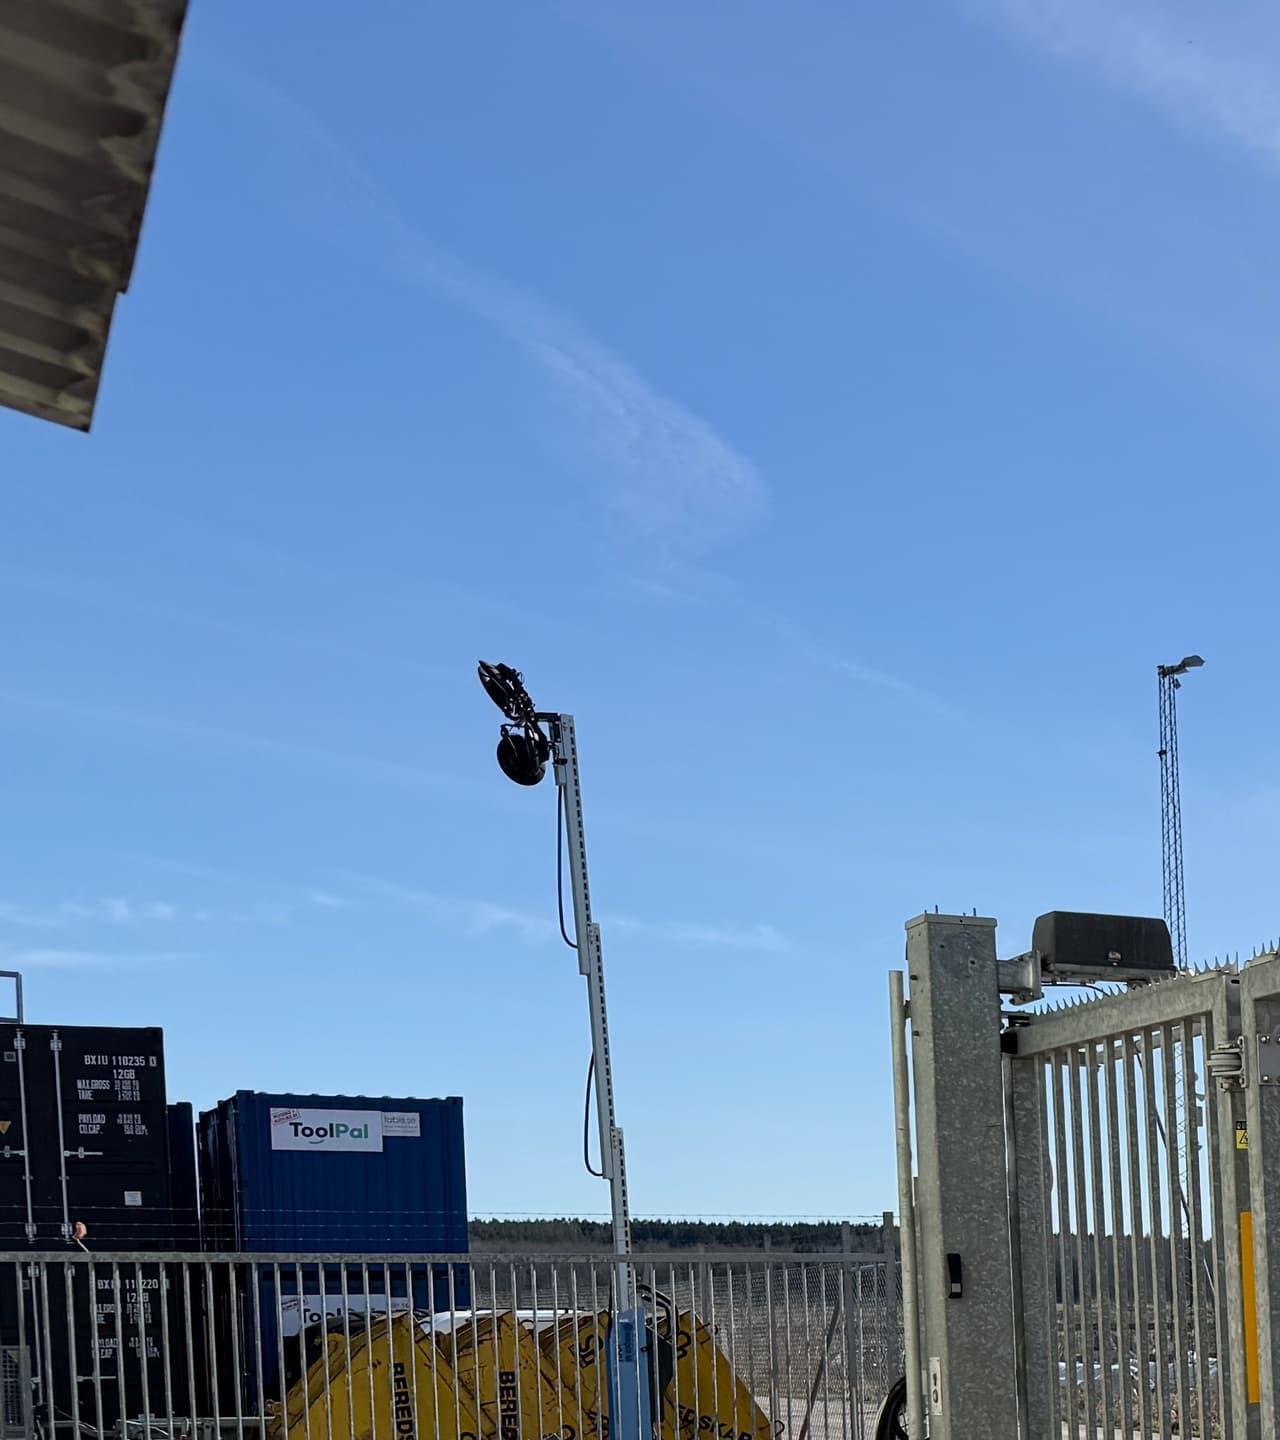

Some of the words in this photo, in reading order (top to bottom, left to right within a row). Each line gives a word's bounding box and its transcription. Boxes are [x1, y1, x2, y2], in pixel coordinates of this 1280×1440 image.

[84, 1055, 108, 1065] BXIU
[112, 1055, 146, 1066] 110235
[112, 1069, 136, 1079] 12GB
[289, 1121, 369, 1139] ToolPal
[125, 1279, 158, 1290] 11220
[126, 1292, 149, 1302] 12B
